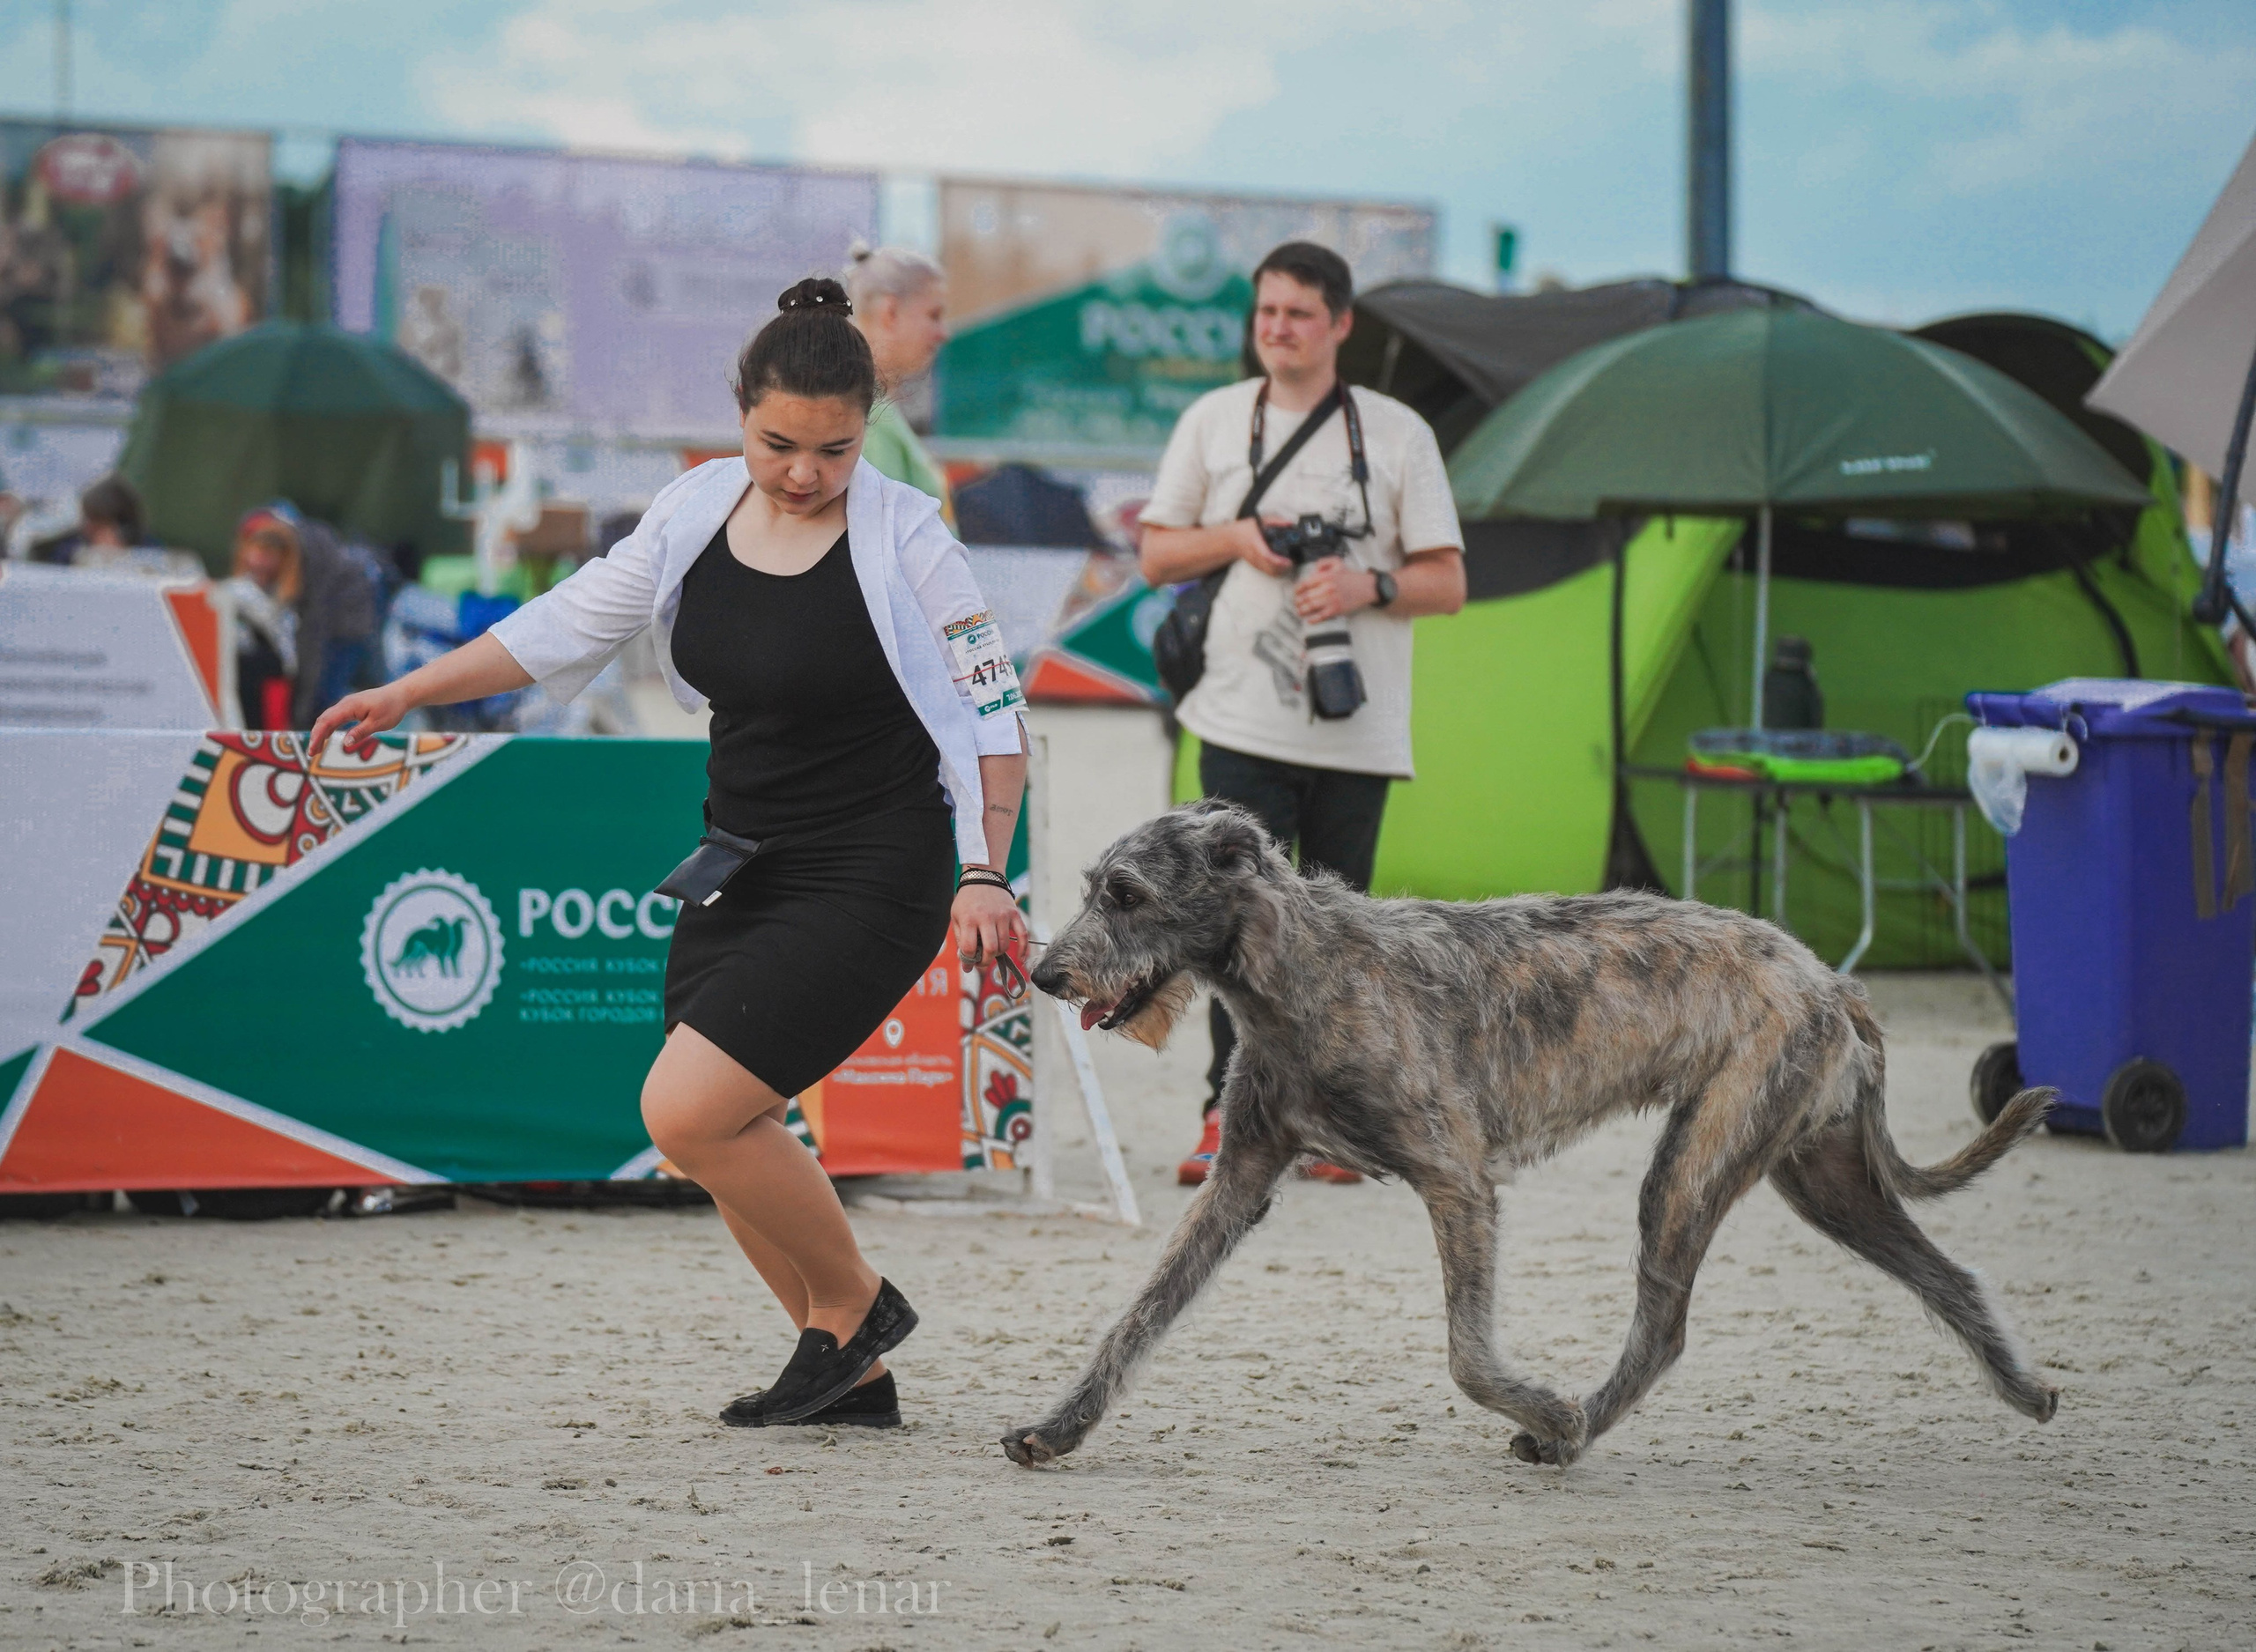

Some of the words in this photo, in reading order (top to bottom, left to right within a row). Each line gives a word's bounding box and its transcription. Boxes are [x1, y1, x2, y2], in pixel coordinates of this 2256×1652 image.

[518, 888, 684, 939] РОСС
[520, 1007, 573, 1022] КУБОК
[578, 1006, 658, 1023] ГОРОДОВ
